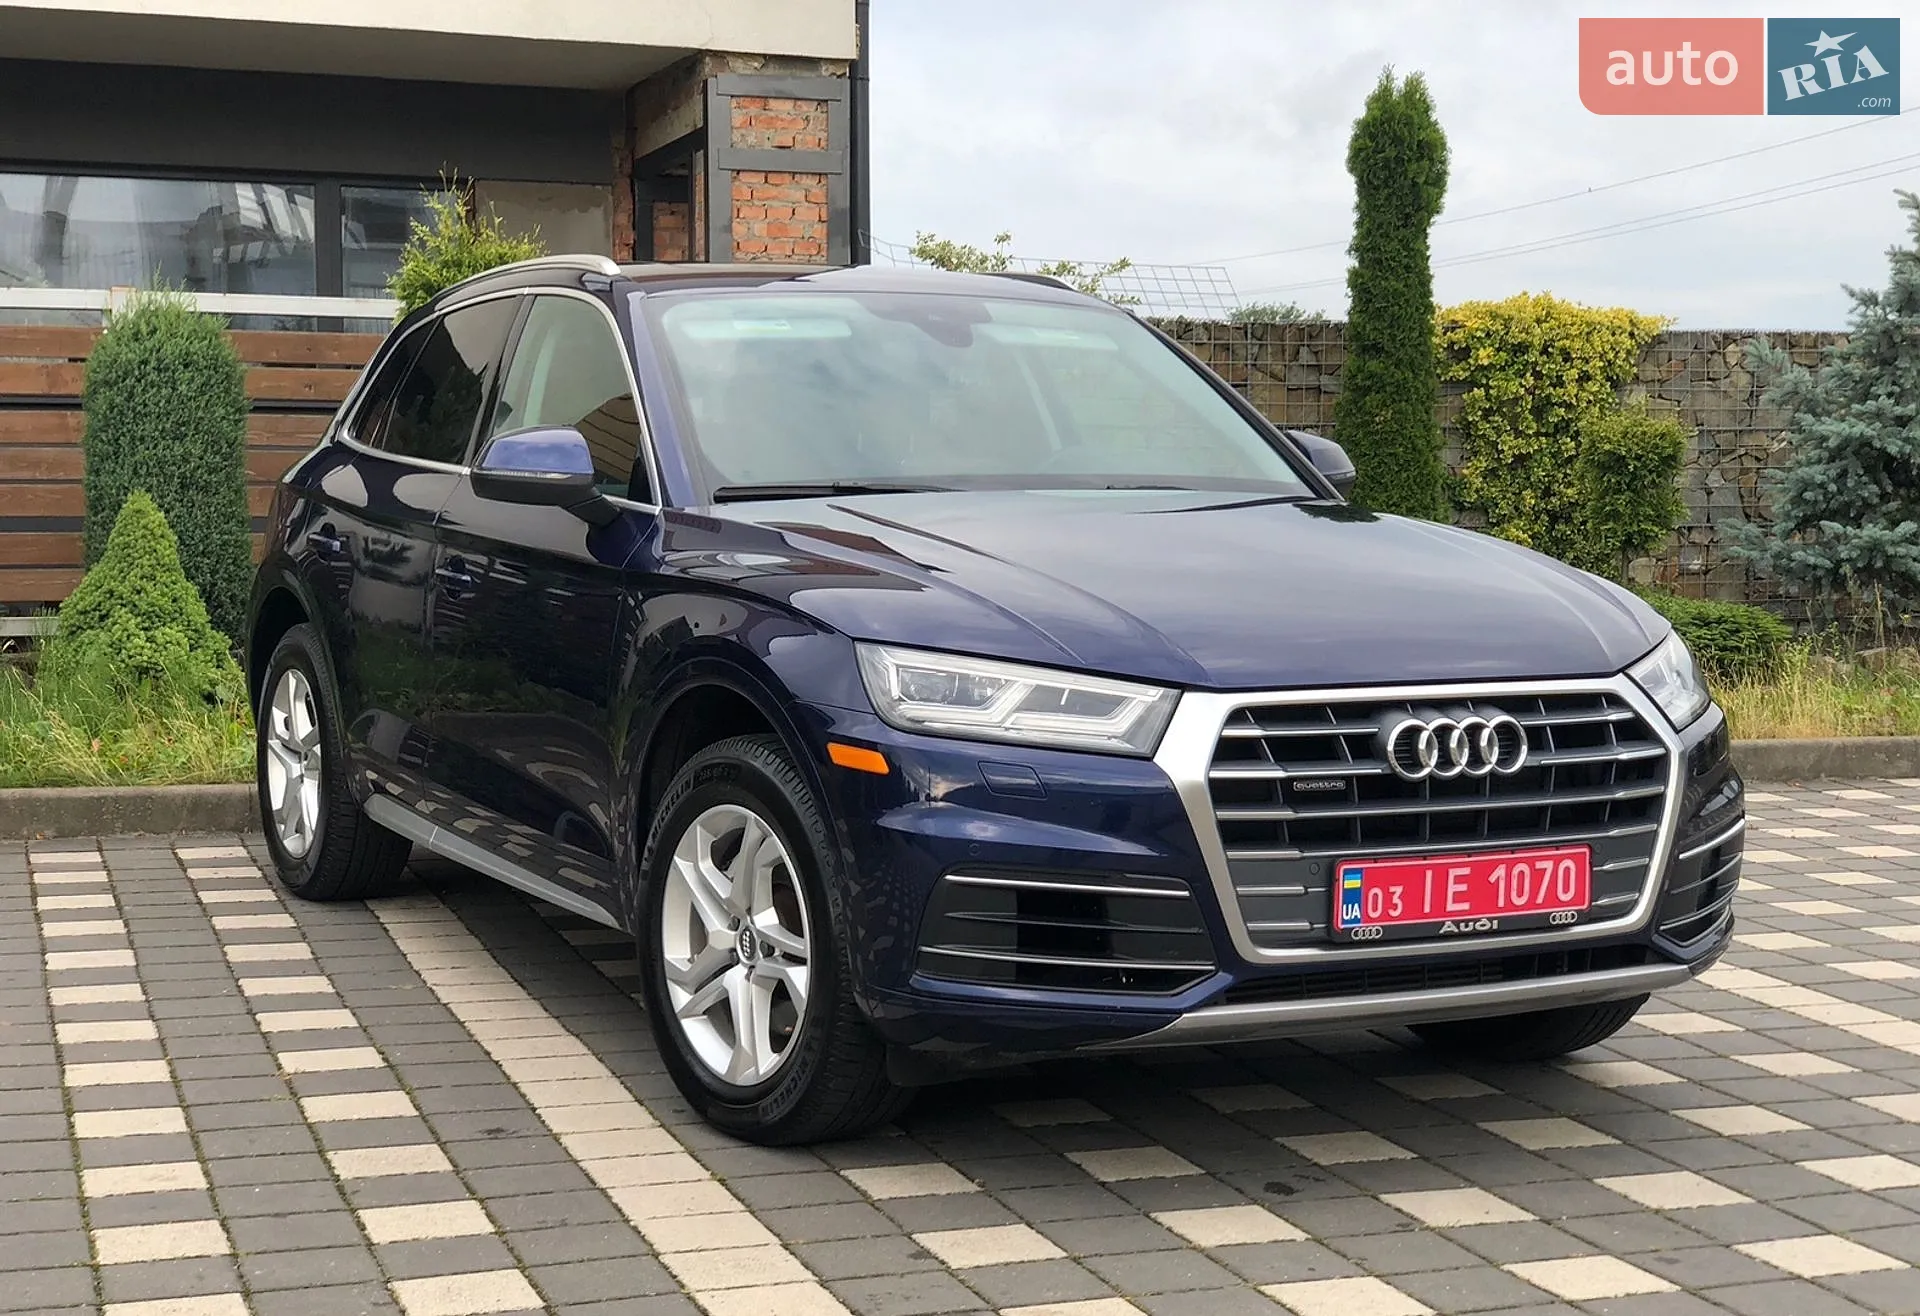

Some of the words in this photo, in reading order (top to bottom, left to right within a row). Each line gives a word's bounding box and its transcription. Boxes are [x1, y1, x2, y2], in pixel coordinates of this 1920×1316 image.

[1295, 781, 1344, 790] quattro
[1342, 904, 1361, 920] UA
[1368, 887, 1404, 919] 03
[1488, 858, 1577, 908] 1070
